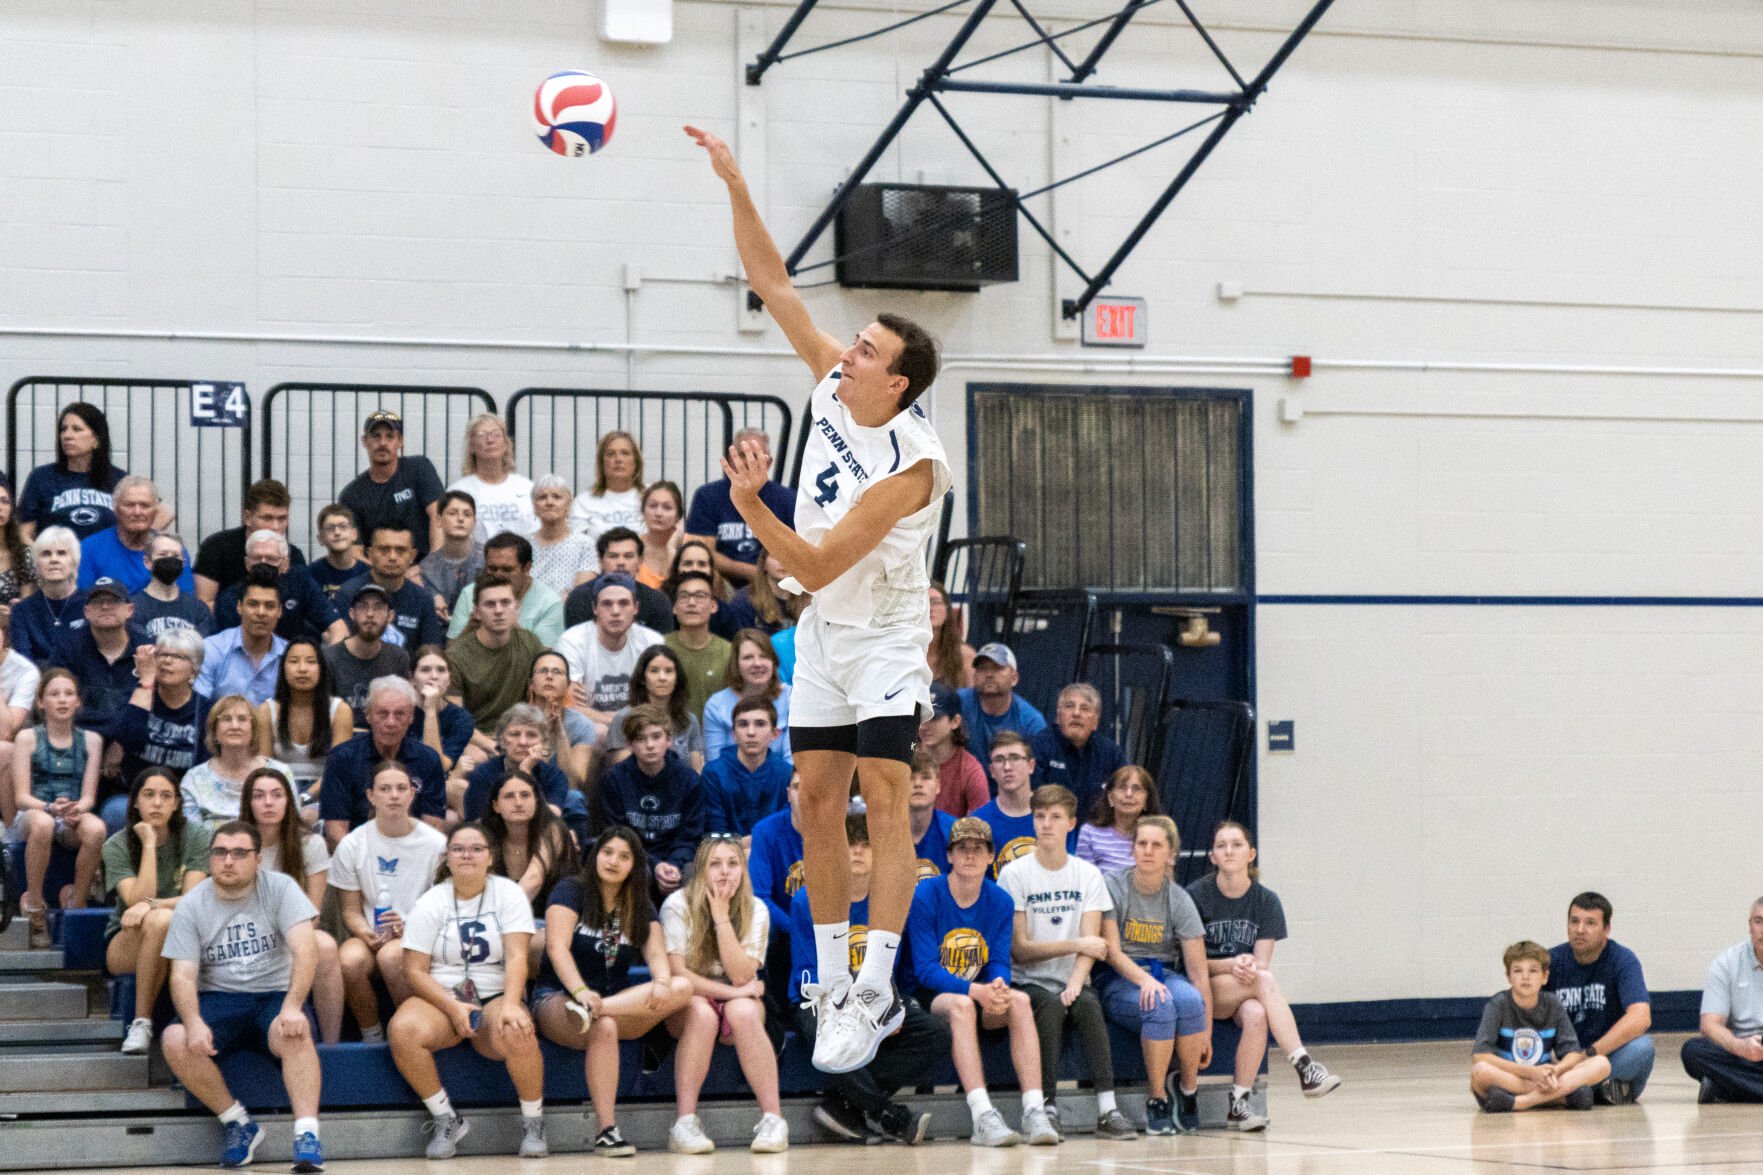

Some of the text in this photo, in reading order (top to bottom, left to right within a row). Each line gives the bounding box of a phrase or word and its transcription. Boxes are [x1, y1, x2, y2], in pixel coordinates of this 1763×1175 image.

[1096, 304, 1136, 338] EXIT
[816, 416, 848, 453] PENN
[814, 461, 841, 508] 4
[51, 488, 80, 511] PENN
[718, 522, 744, 540] PENN
[1026, 890, 1082, 906] PENN STAE
[1032, 904, 1076, 914] VOLLEYBAL
[227, 922, 257, 942] IT'S
[1125, 921, 1164, 943] VIKINGS
[206, 934, 278, 961] GAMEDAY
[1584, 984, 1606, 1004] SATE
